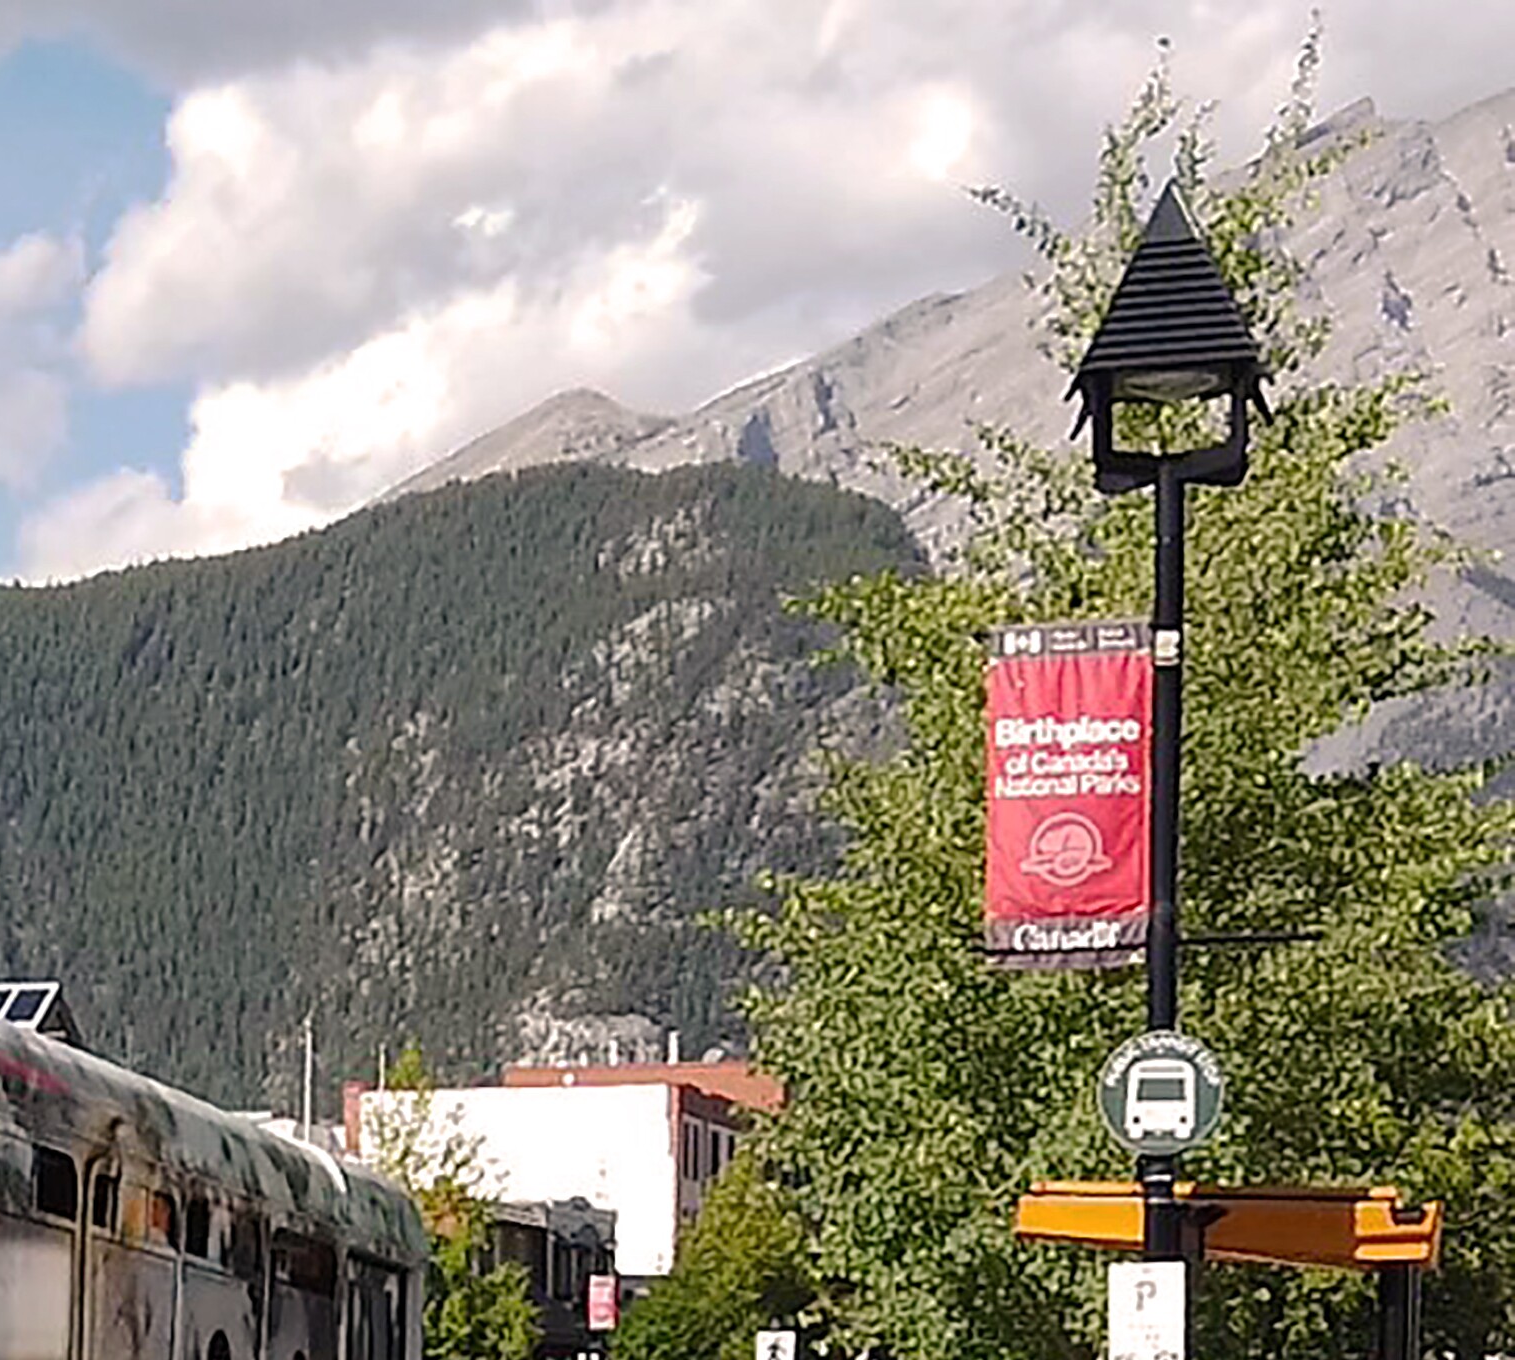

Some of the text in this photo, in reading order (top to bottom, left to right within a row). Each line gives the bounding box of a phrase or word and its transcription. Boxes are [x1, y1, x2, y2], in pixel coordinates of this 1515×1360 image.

[995, 716, 1141, 750] Birthplace
[1005, 749, 1129, 775] of Canada's
[995, 771, 1141, 799] National Parks
